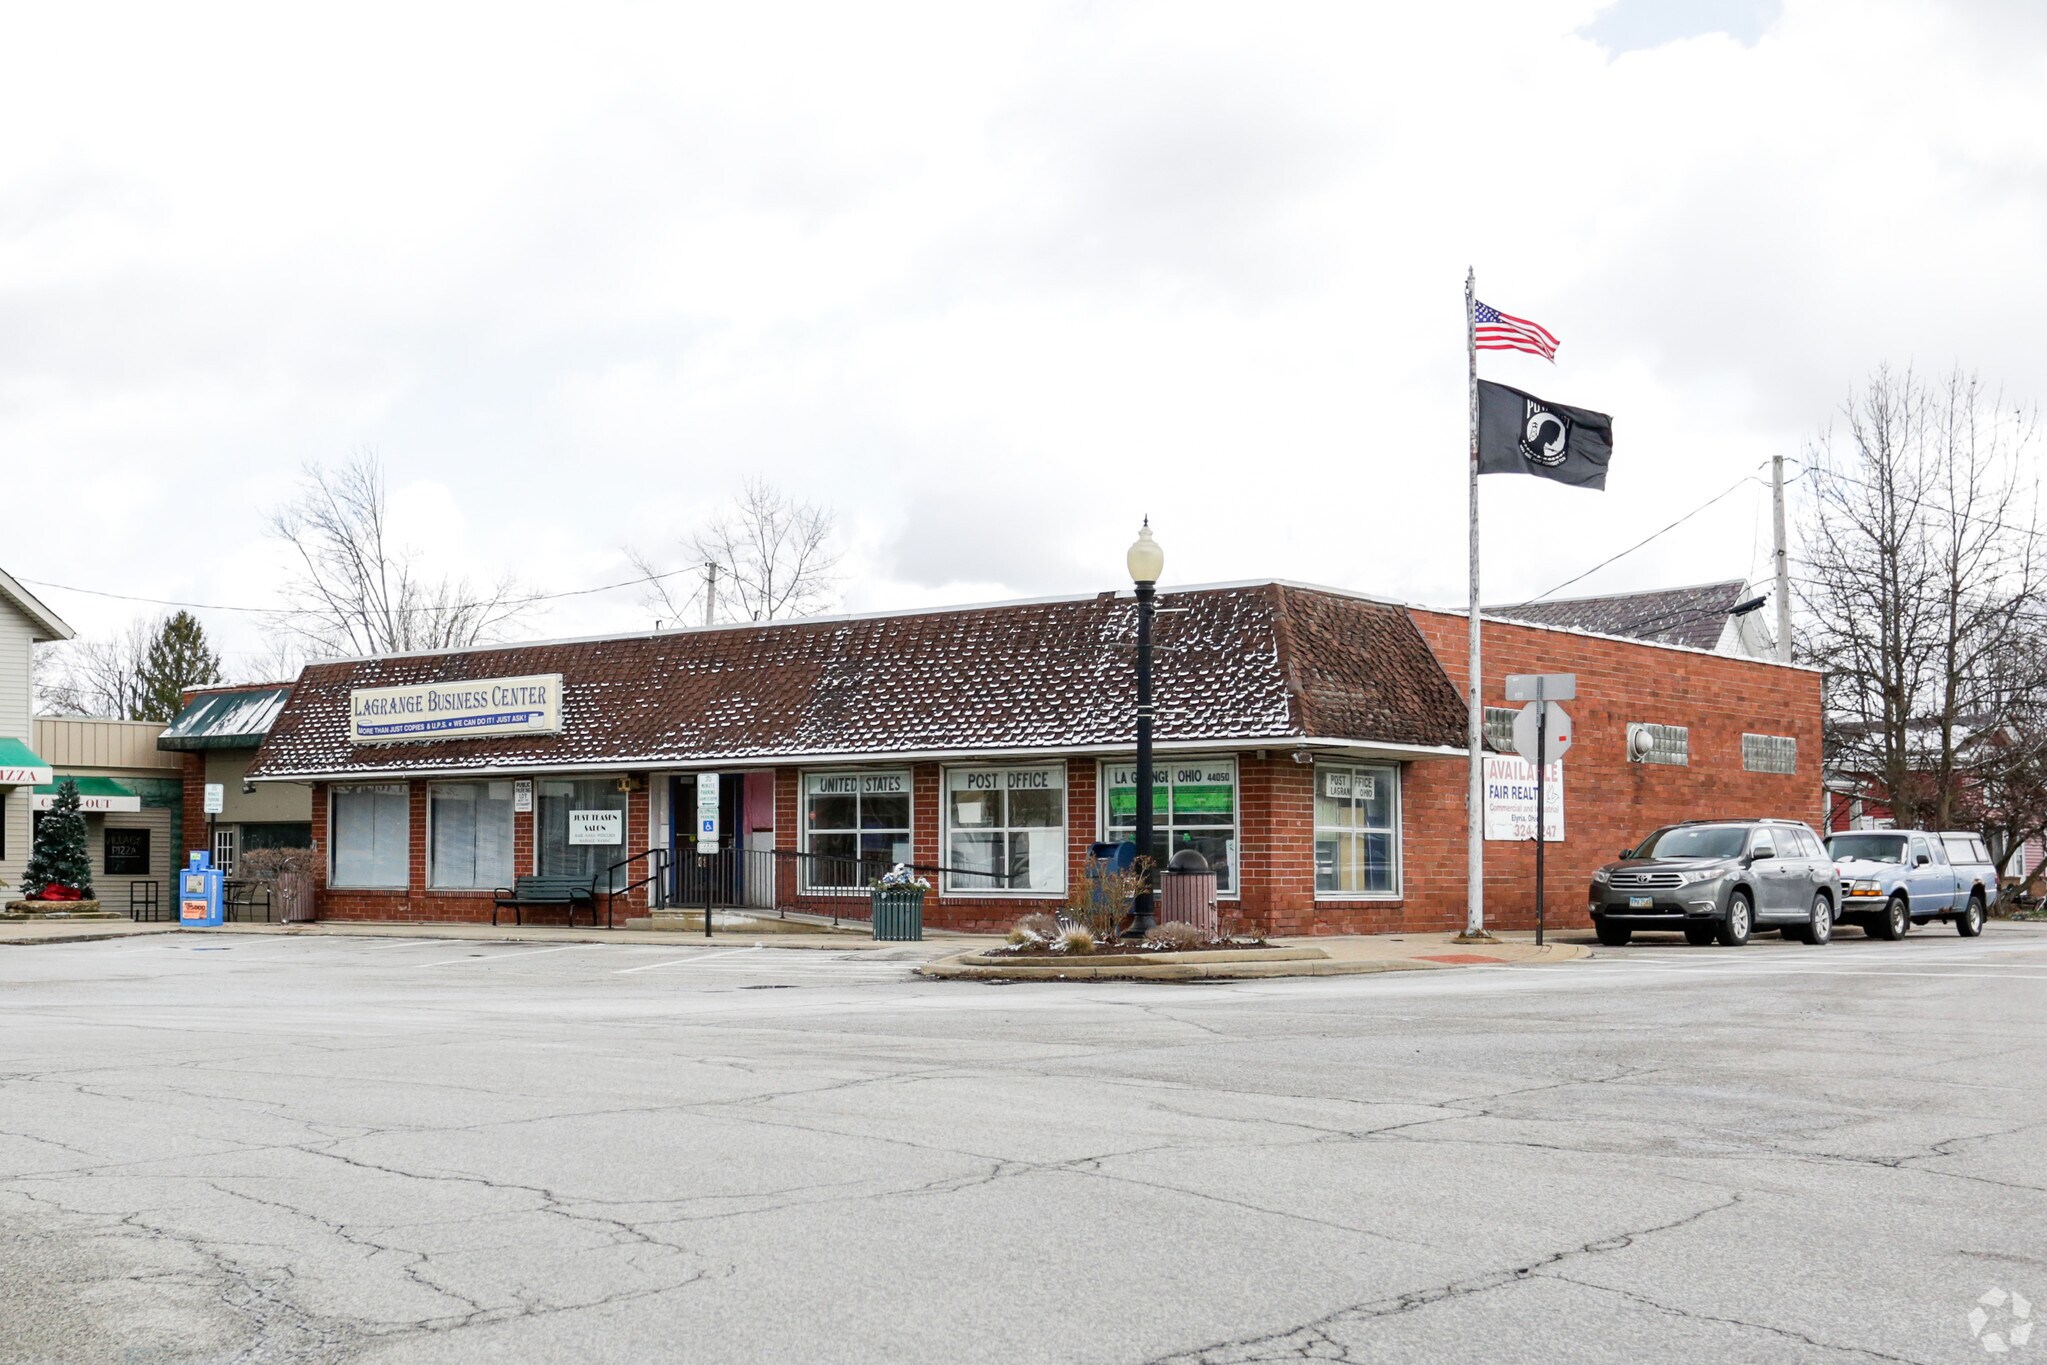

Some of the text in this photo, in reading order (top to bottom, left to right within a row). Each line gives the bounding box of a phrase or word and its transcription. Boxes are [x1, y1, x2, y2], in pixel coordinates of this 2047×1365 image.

[354, 685, 546, 717] LAGRANGE BUSINESS CENTER
[358, 727, 374, 735] MORE
[374, 726, 390, 734] THAN
[389, 724, 403, 733] JUST
[403, 723, 425, 732] COPIES
[453, 720, 463, 728] WE
[463, 719, 476, 727] CAN
[496, 716, 511, 724] JUST
[511, 714, 527, 723] ASK!
[1114, 769, 1230, 785] LA GNGE OHIO 44050
[1489, 759, 1558, 783] AVAILALE
[820, 776, 901, 793] UNITED STATES
[968, 771, 1048, 789] POST OFFICE
[1330, 774, 1372, 788] POST FFICE
[1330, 786, 1373, 797] LAGRAN OHIO
[1489, 785, 1539, 801] FAIR REALT
[111, 846, 137, 855] PIZZA
